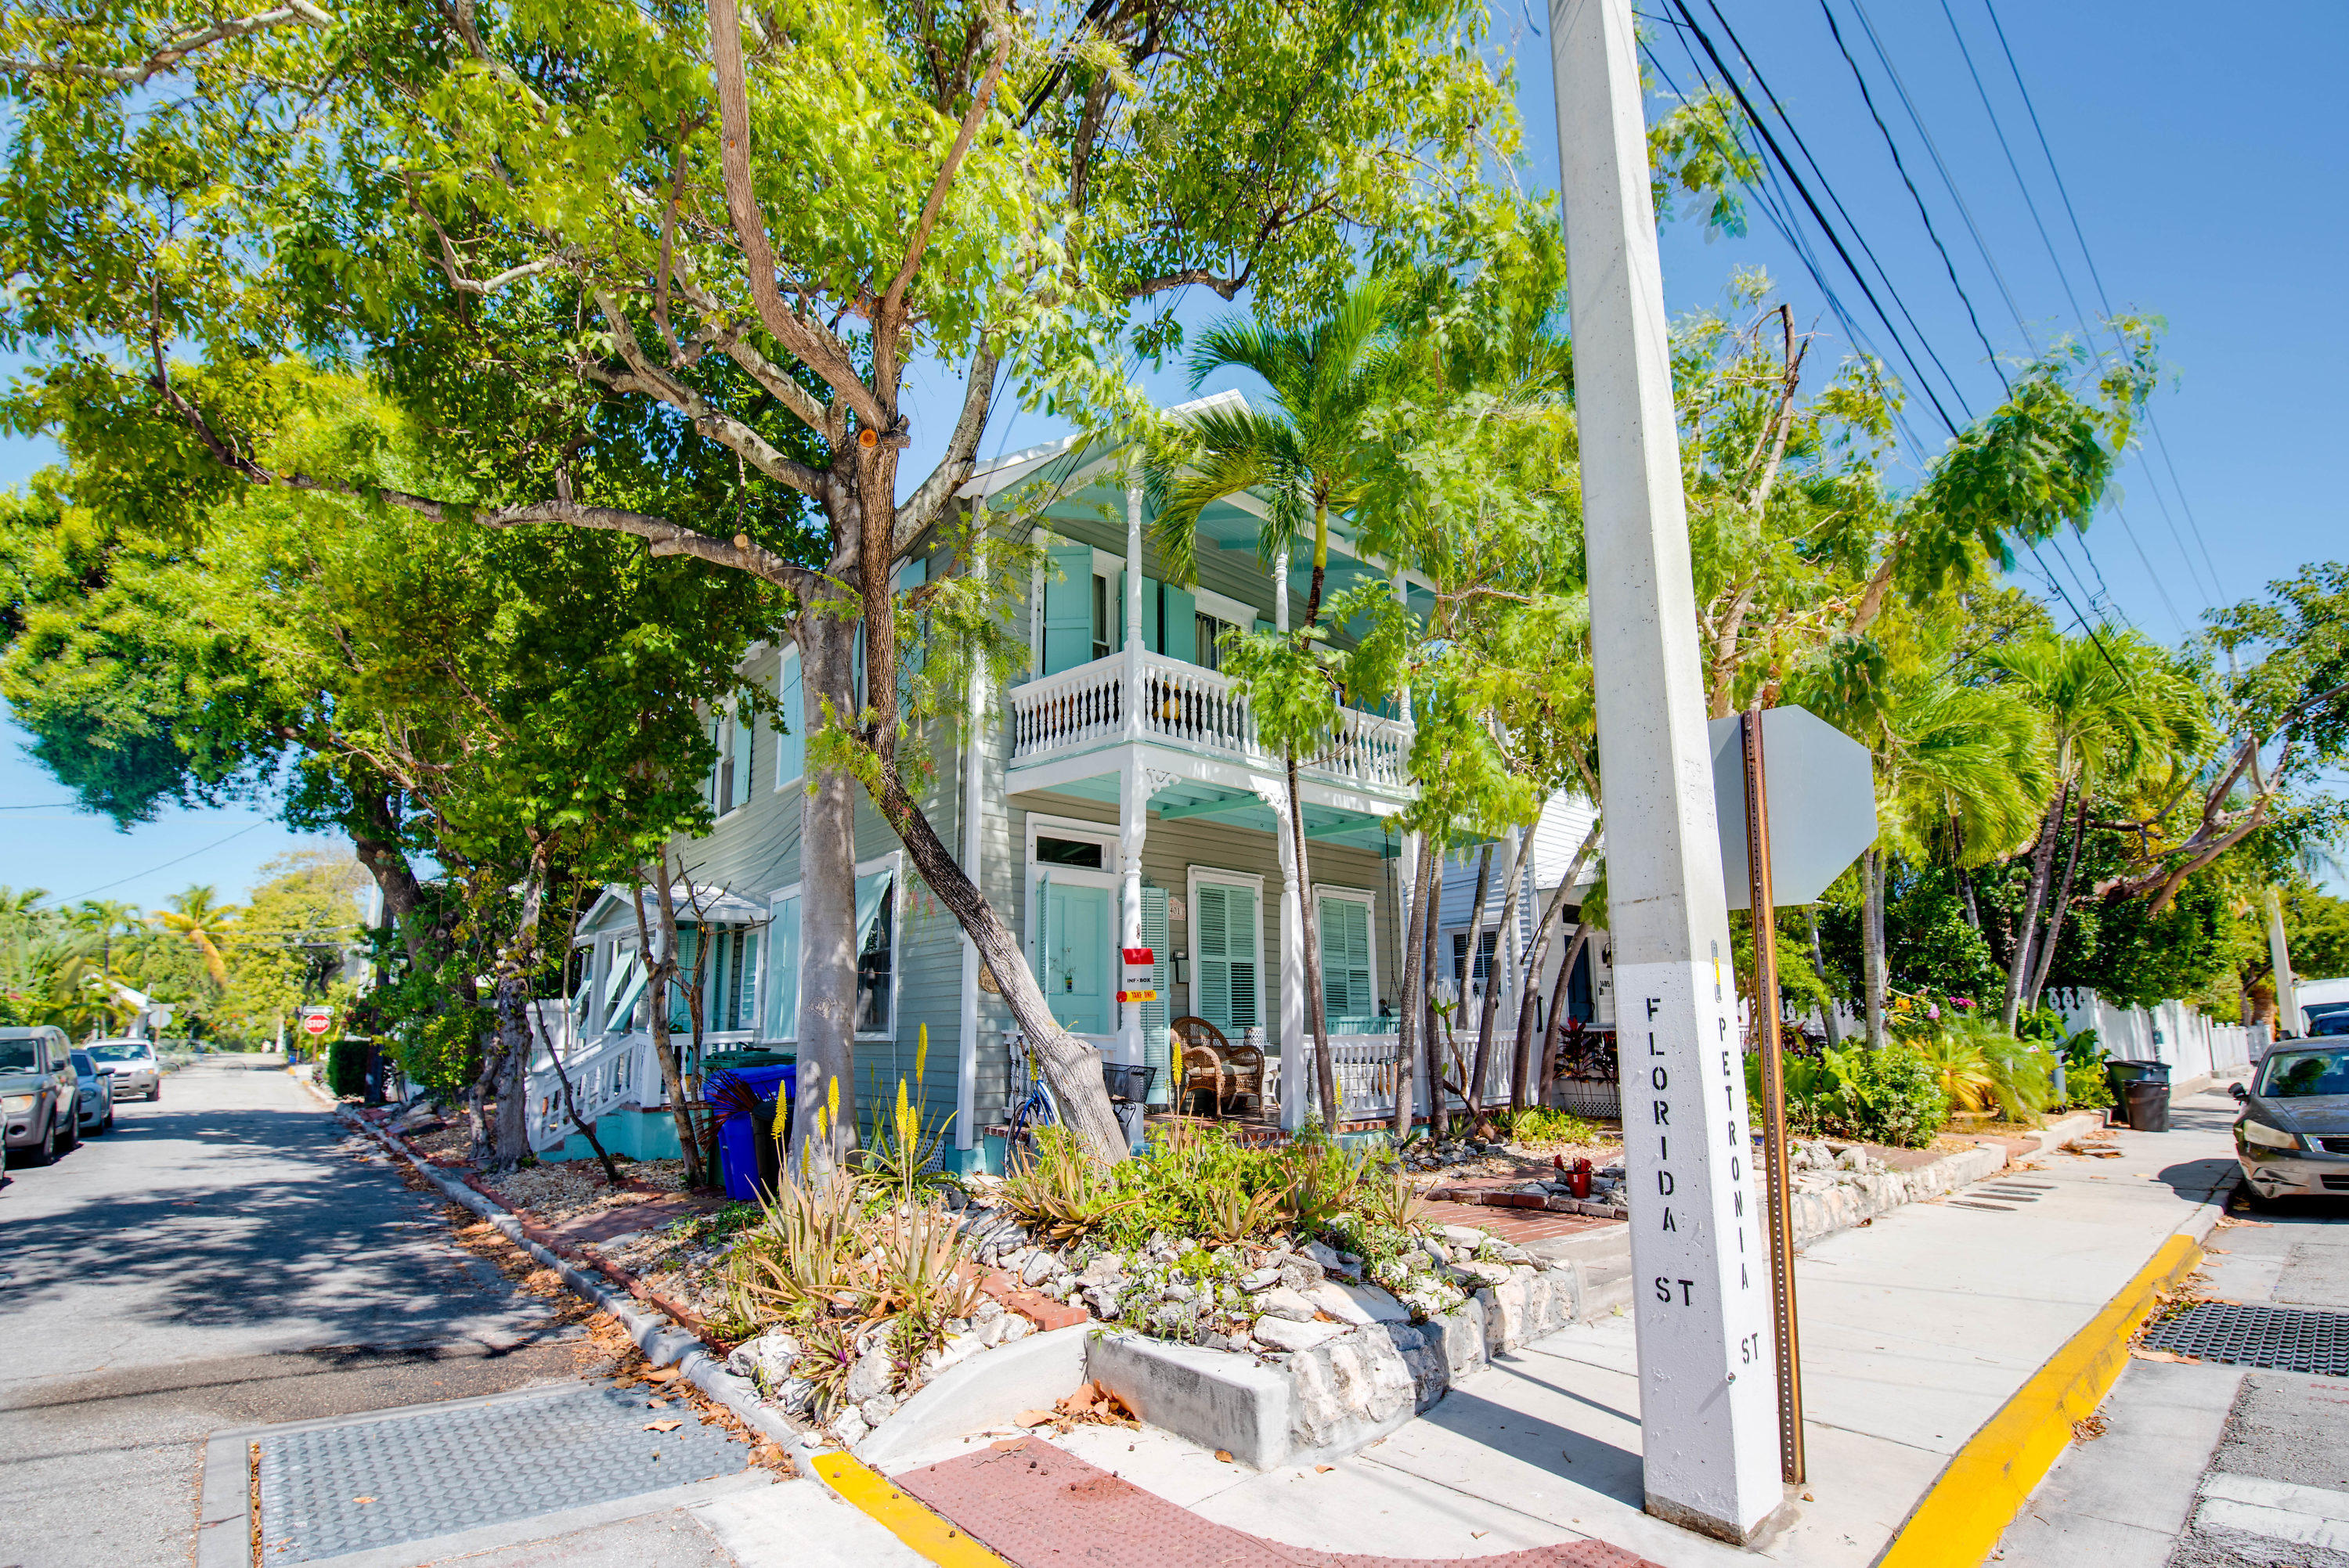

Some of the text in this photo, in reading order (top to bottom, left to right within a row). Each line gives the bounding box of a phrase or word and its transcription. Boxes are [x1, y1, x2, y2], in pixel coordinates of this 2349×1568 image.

[306, 1019, 328, 1028] STOP
[1647, 997, 1694, 1307] FLORIDA ST
[1719, 1017, 1758, 1364] PETRONIA ST
